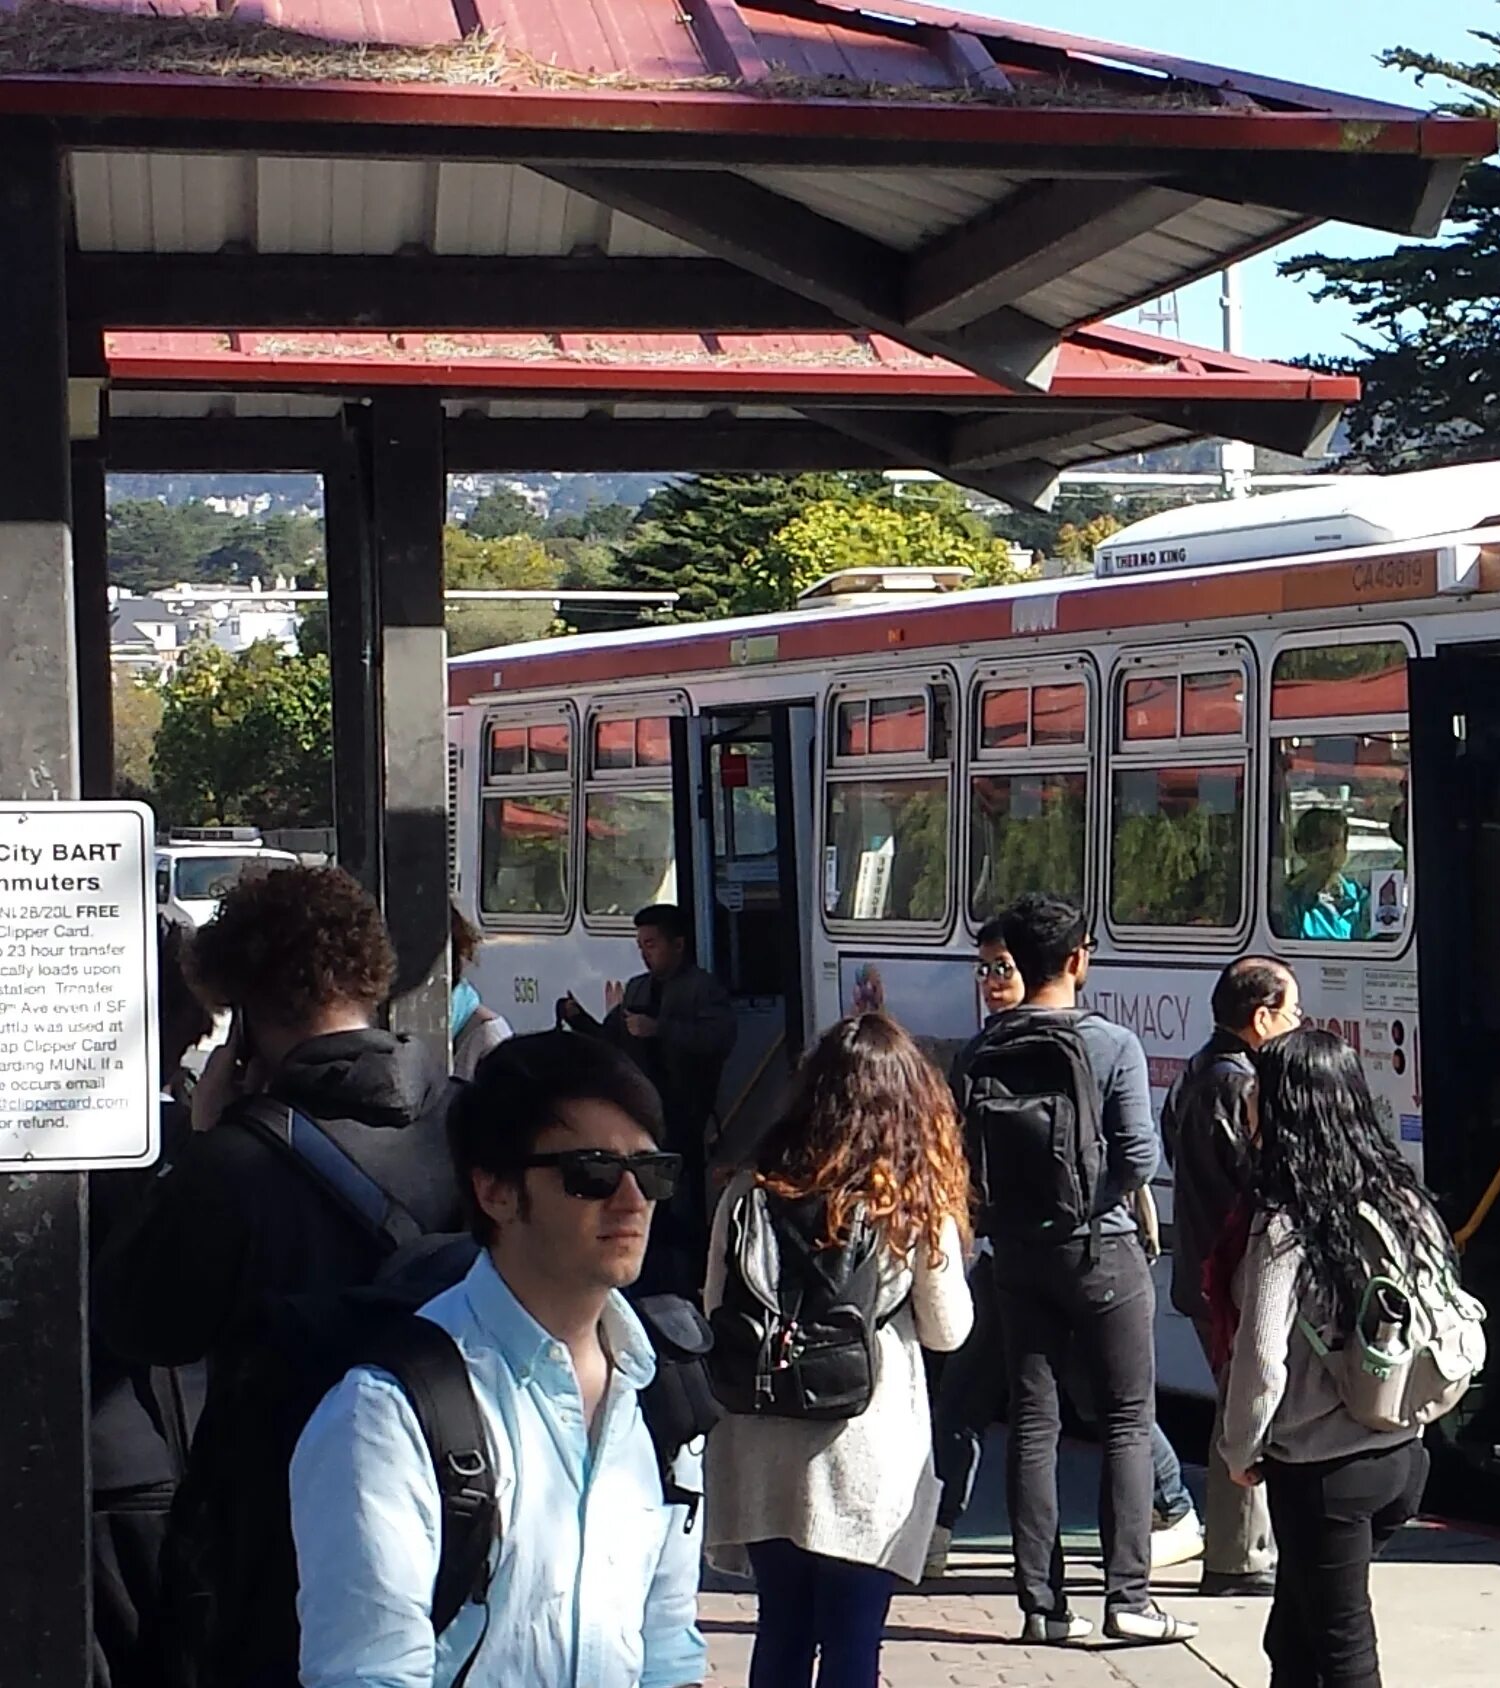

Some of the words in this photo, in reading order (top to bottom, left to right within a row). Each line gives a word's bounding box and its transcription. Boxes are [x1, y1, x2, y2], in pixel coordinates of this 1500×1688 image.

[1159, 547, 1186, 564] KING
[53, 843, 122, 861] BART
[76, 904, 120, 918] FREE
[31, 944, 64, 957] hour
[69, 942, 125, 956] transfer
[38, 963, 79, 976] loads
[83, 965, 121, 978] upon
[106, 999, 127, 1014] SF
[68, 1021, 104, 1033] used
[109, 1020, 124, 1033] at
[24, 1039, 77, 1054] Clipper
[82, 1038, 117, 1052] Card
[114, 1060, 123, 1070] a
[10, 1081, 61, 1091] occurs
[65, 1077, 105, 1089] email
[17, 1116, 69, 1129] refund.
